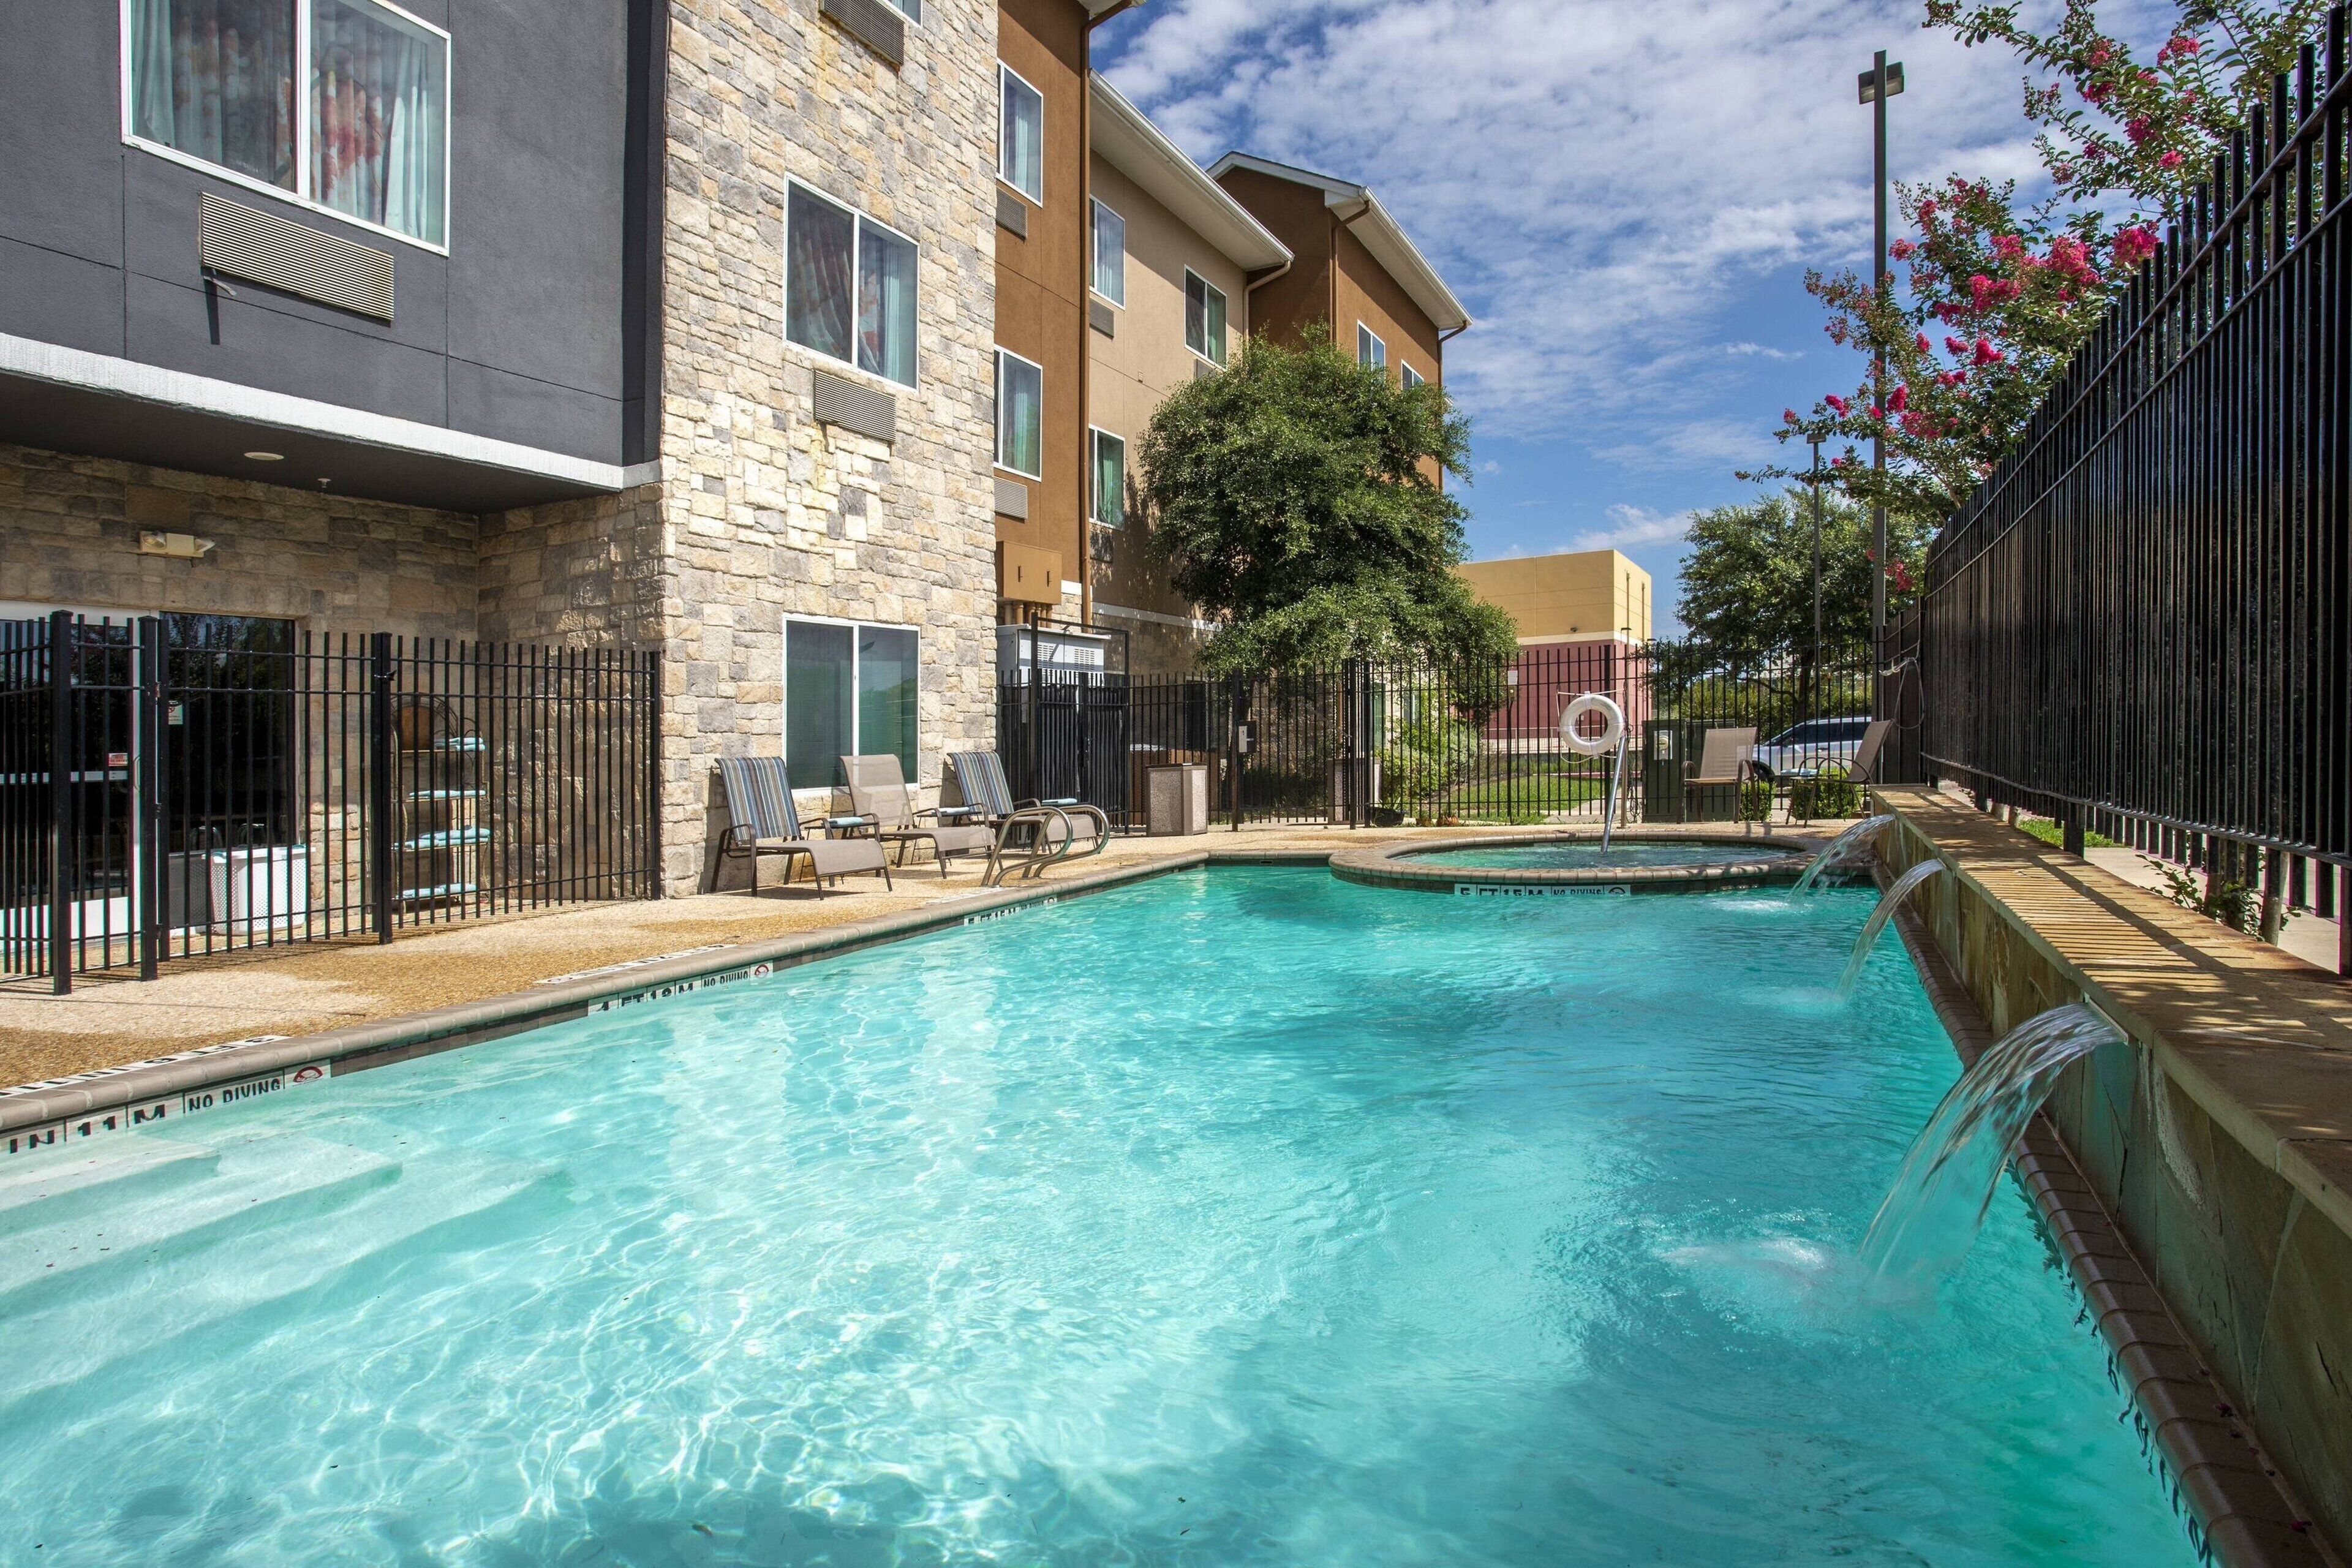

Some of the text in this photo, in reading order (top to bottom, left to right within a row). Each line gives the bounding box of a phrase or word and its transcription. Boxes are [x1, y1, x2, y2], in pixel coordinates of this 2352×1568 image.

[704, 978, 716, 987] NO
[720, 970, 748, 984] DIVING
[134, 1104, 165, 1125] M
[189, 1093, 214, 1112] NO
[222, 1078, 281, 1103] DIVING
